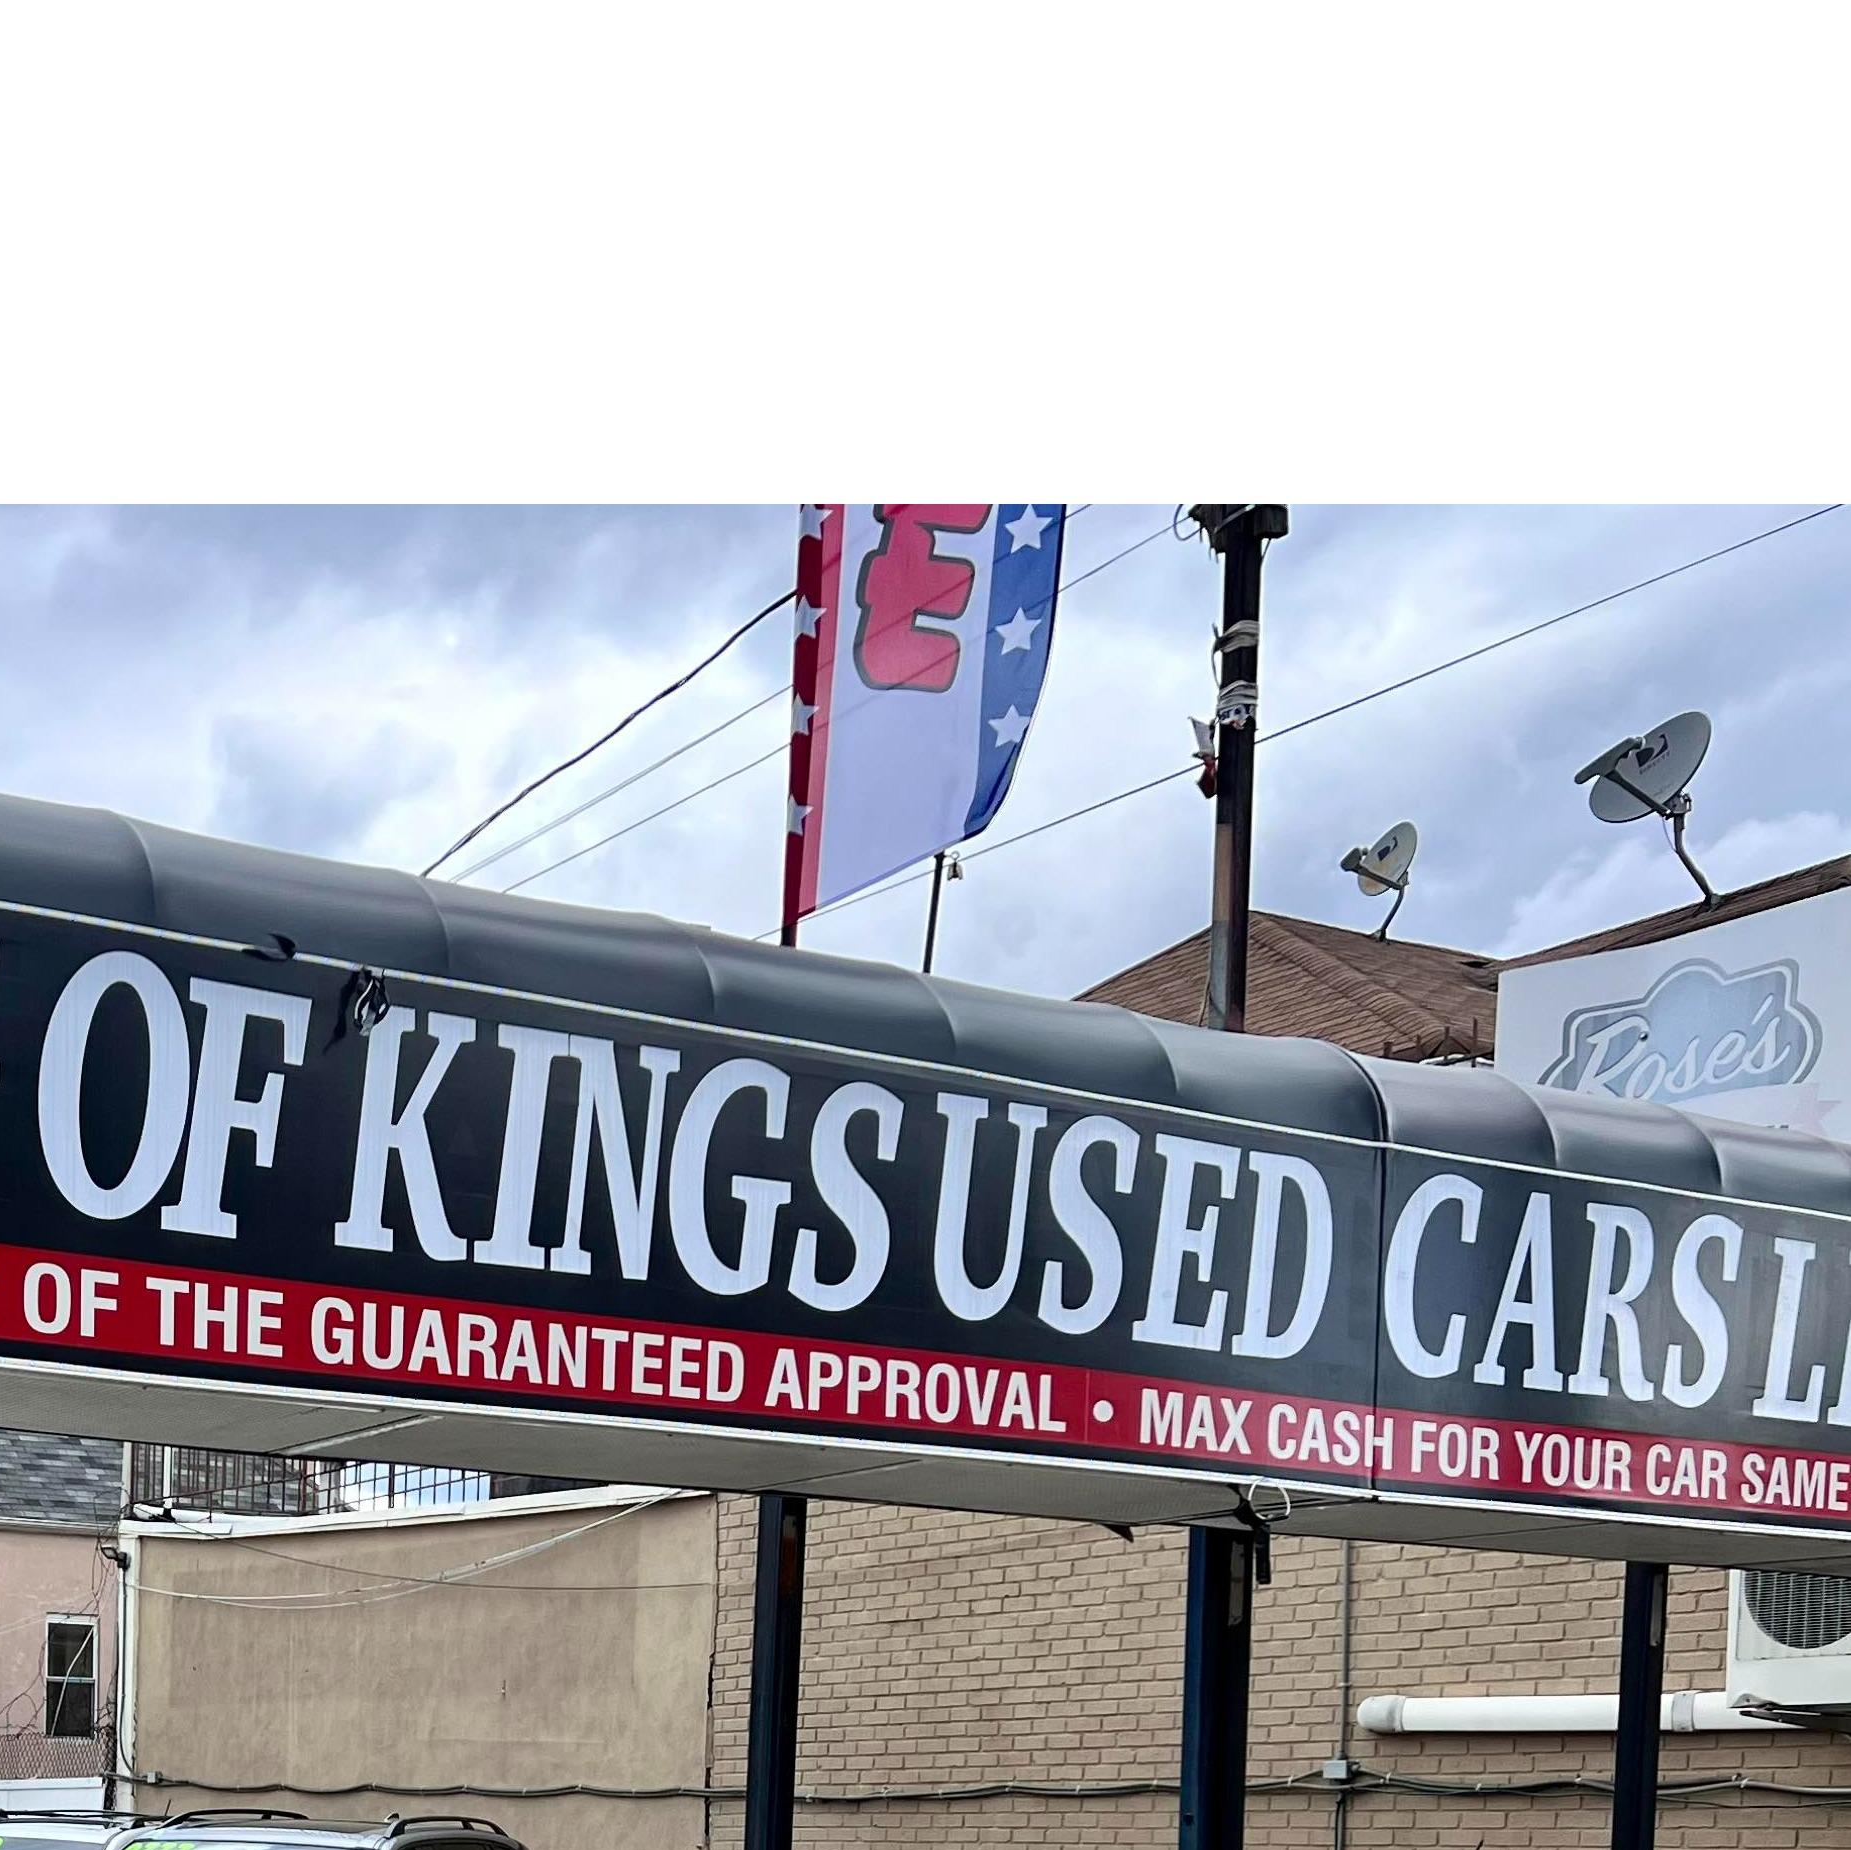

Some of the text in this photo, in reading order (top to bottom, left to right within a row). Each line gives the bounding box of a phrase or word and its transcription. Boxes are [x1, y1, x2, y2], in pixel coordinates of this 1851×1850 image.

[37, 949, 313, 1239] OF
[334, 1003, 905, 1313] KINGS
[932, 1091, 1334, 1359] USED
[1384, 1173, 1745, 1409] CARS
[23, 1262, 119, 1338] OF
[145, 1277, 284, 1357] THE
[310, 1296, 745, 1404] GUARANTEED
[764, 1347, 1068, 1433] APPROVAL
[1139, 1387, 1849, 1512] MAX CASH FOR YOUR CAR SAME
